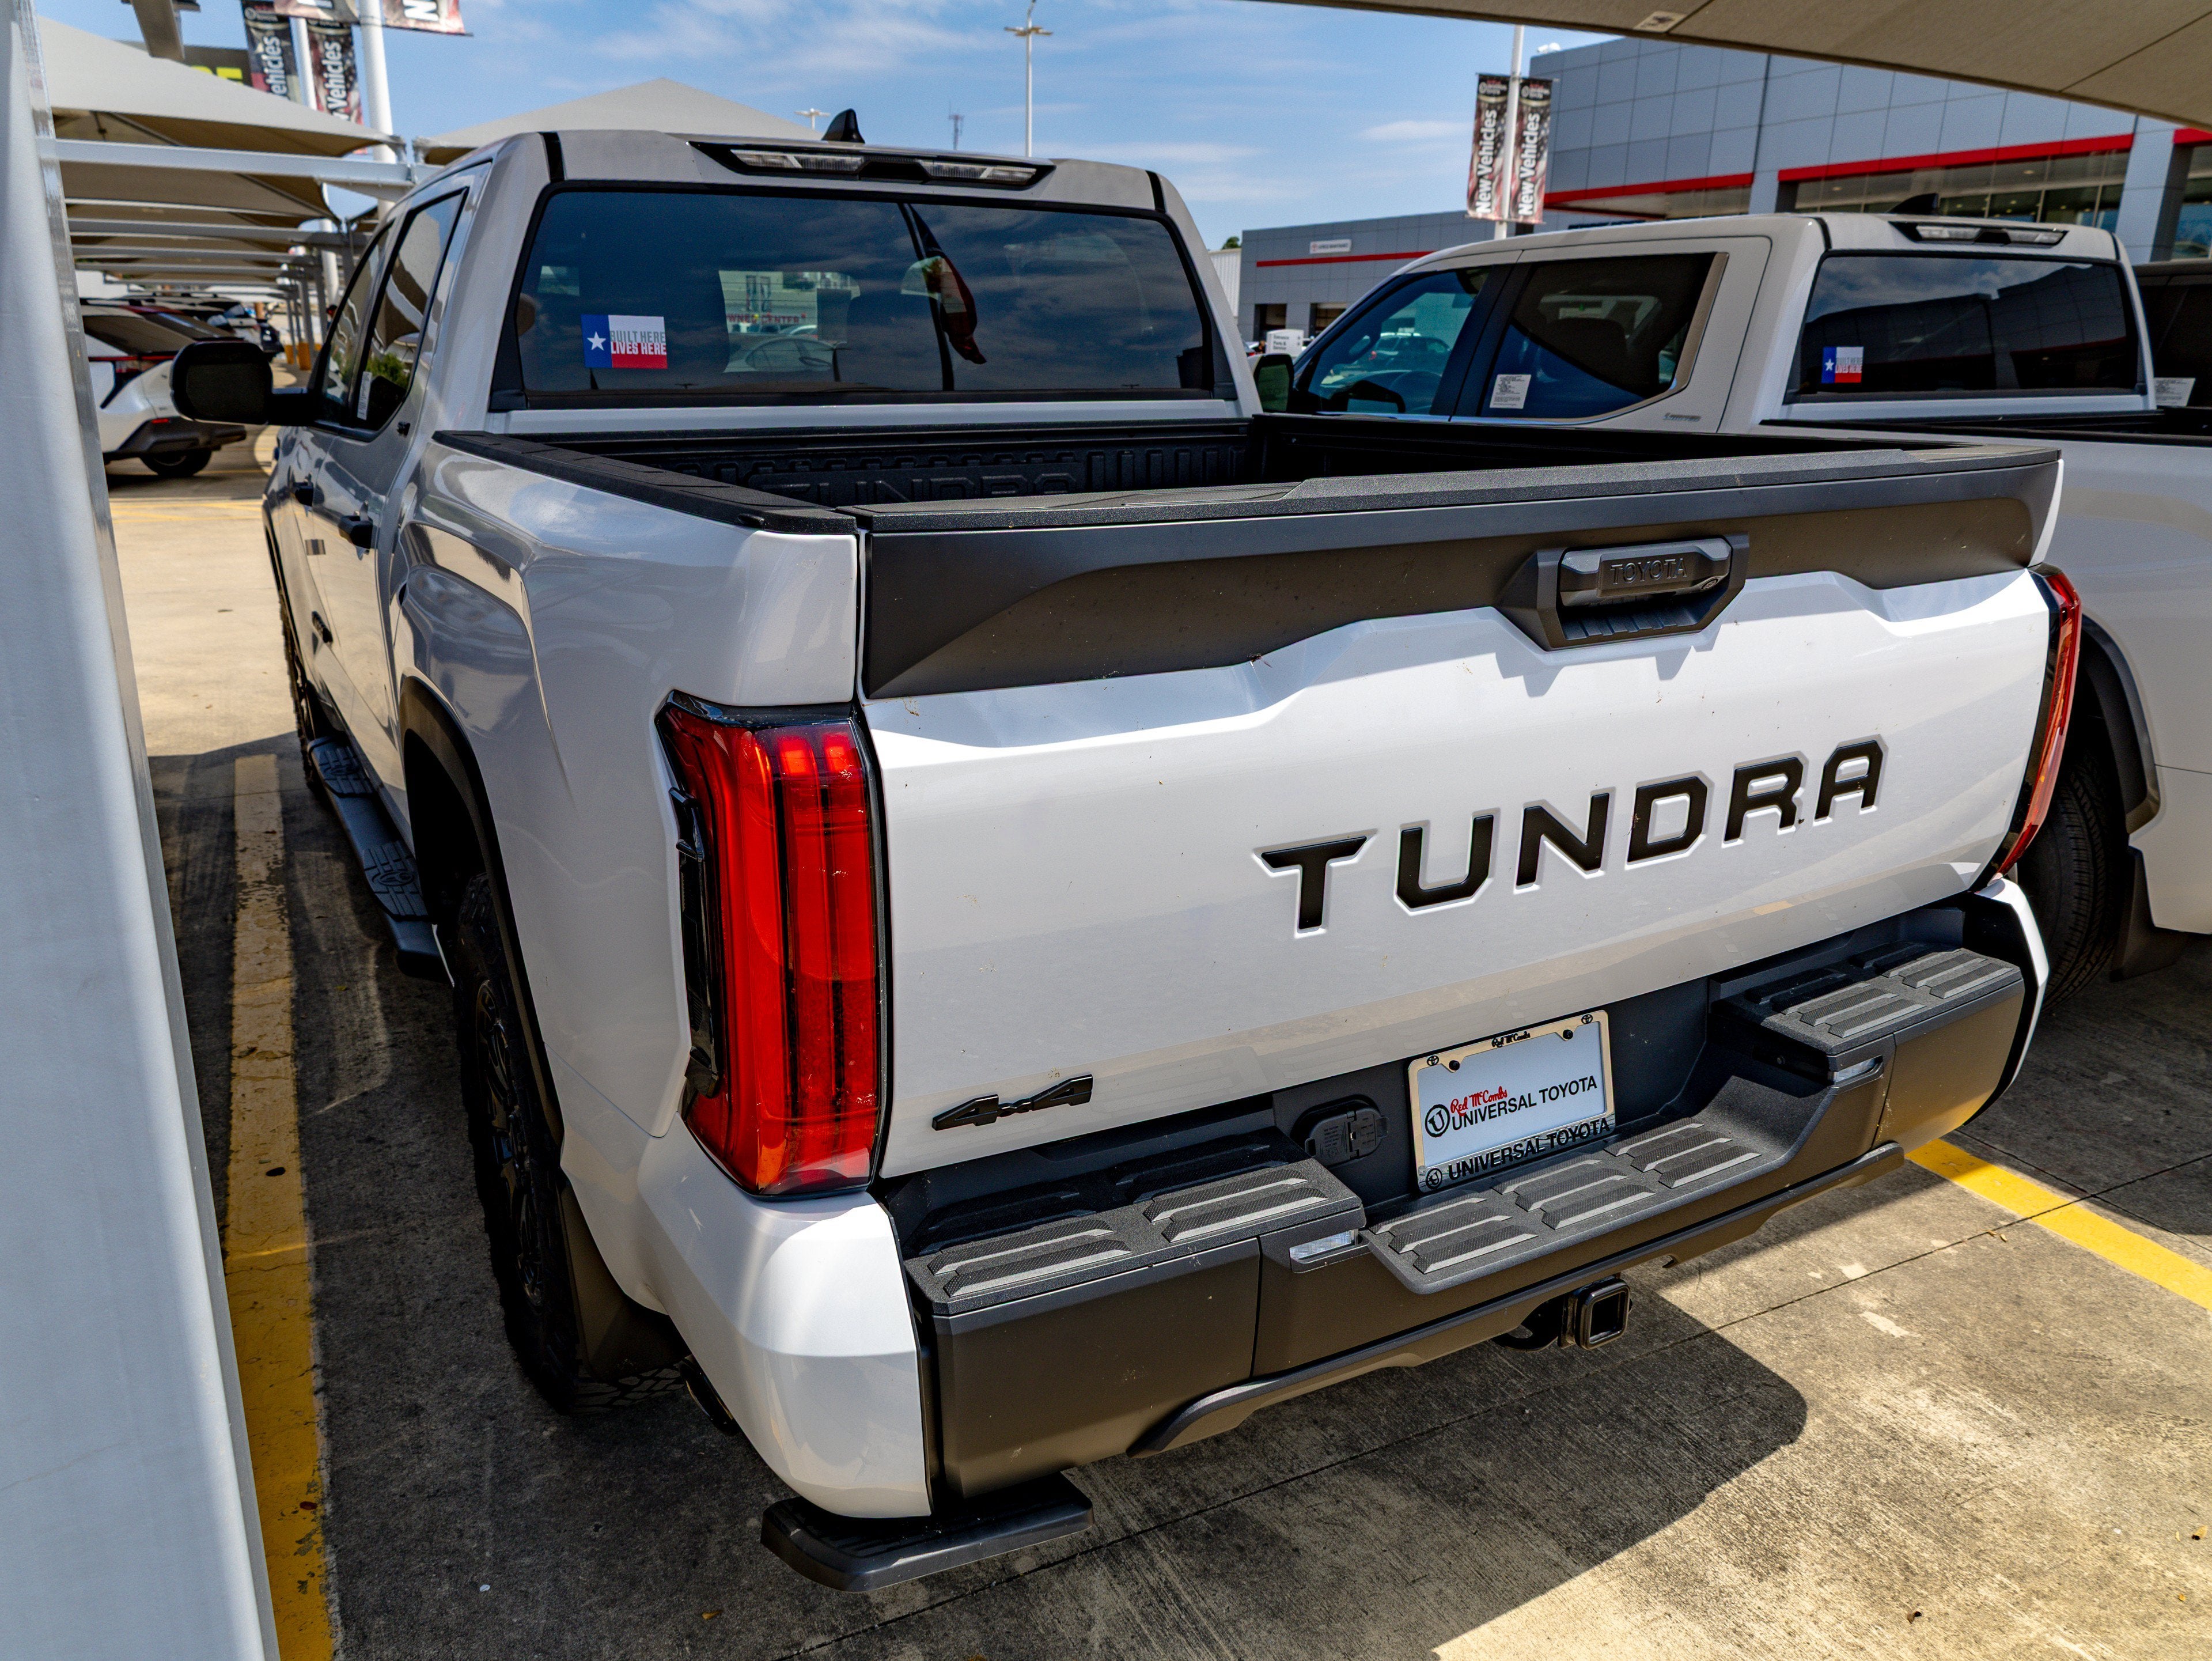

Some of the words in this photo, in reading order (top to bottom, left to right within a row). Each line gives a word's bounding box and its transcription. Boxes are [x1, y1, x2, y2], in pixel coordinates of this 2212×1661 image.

[261, 36, 287, 95] ehicles
[322, 41, 347, 109] Vehicles
[1478, 109, 1497, 178] Vehicles
[1520, 113, 1540, 179] Vehicles
[1476, 179, 1492, 214] New
[1518, 182, 1535, 215] New
[610, 331, 638, 342] BUILT
[640, 331, 665, 343] HERE
[611, 342, 639, 354] LIVES
[641, 343, 666, 355] HERE
[1609, 558, 1688, 585] TOYOTA
[1256, 736, 1887, 936] TUNDRA
[1491, 1038, 1504, 1047] Red
[1450, 1096, 1468, 1117] Red
[1469, 1086, 1508, 1107] McCombs
[1452, 1093, 1537, 1130] UNIVERSAL
[1539, 1076, 1597, 1103] TOYOTA
[1448, 1137, 1546, 1180] UNIVERSAL
[1547, 1118, 1610, 1149] TOYOTA
